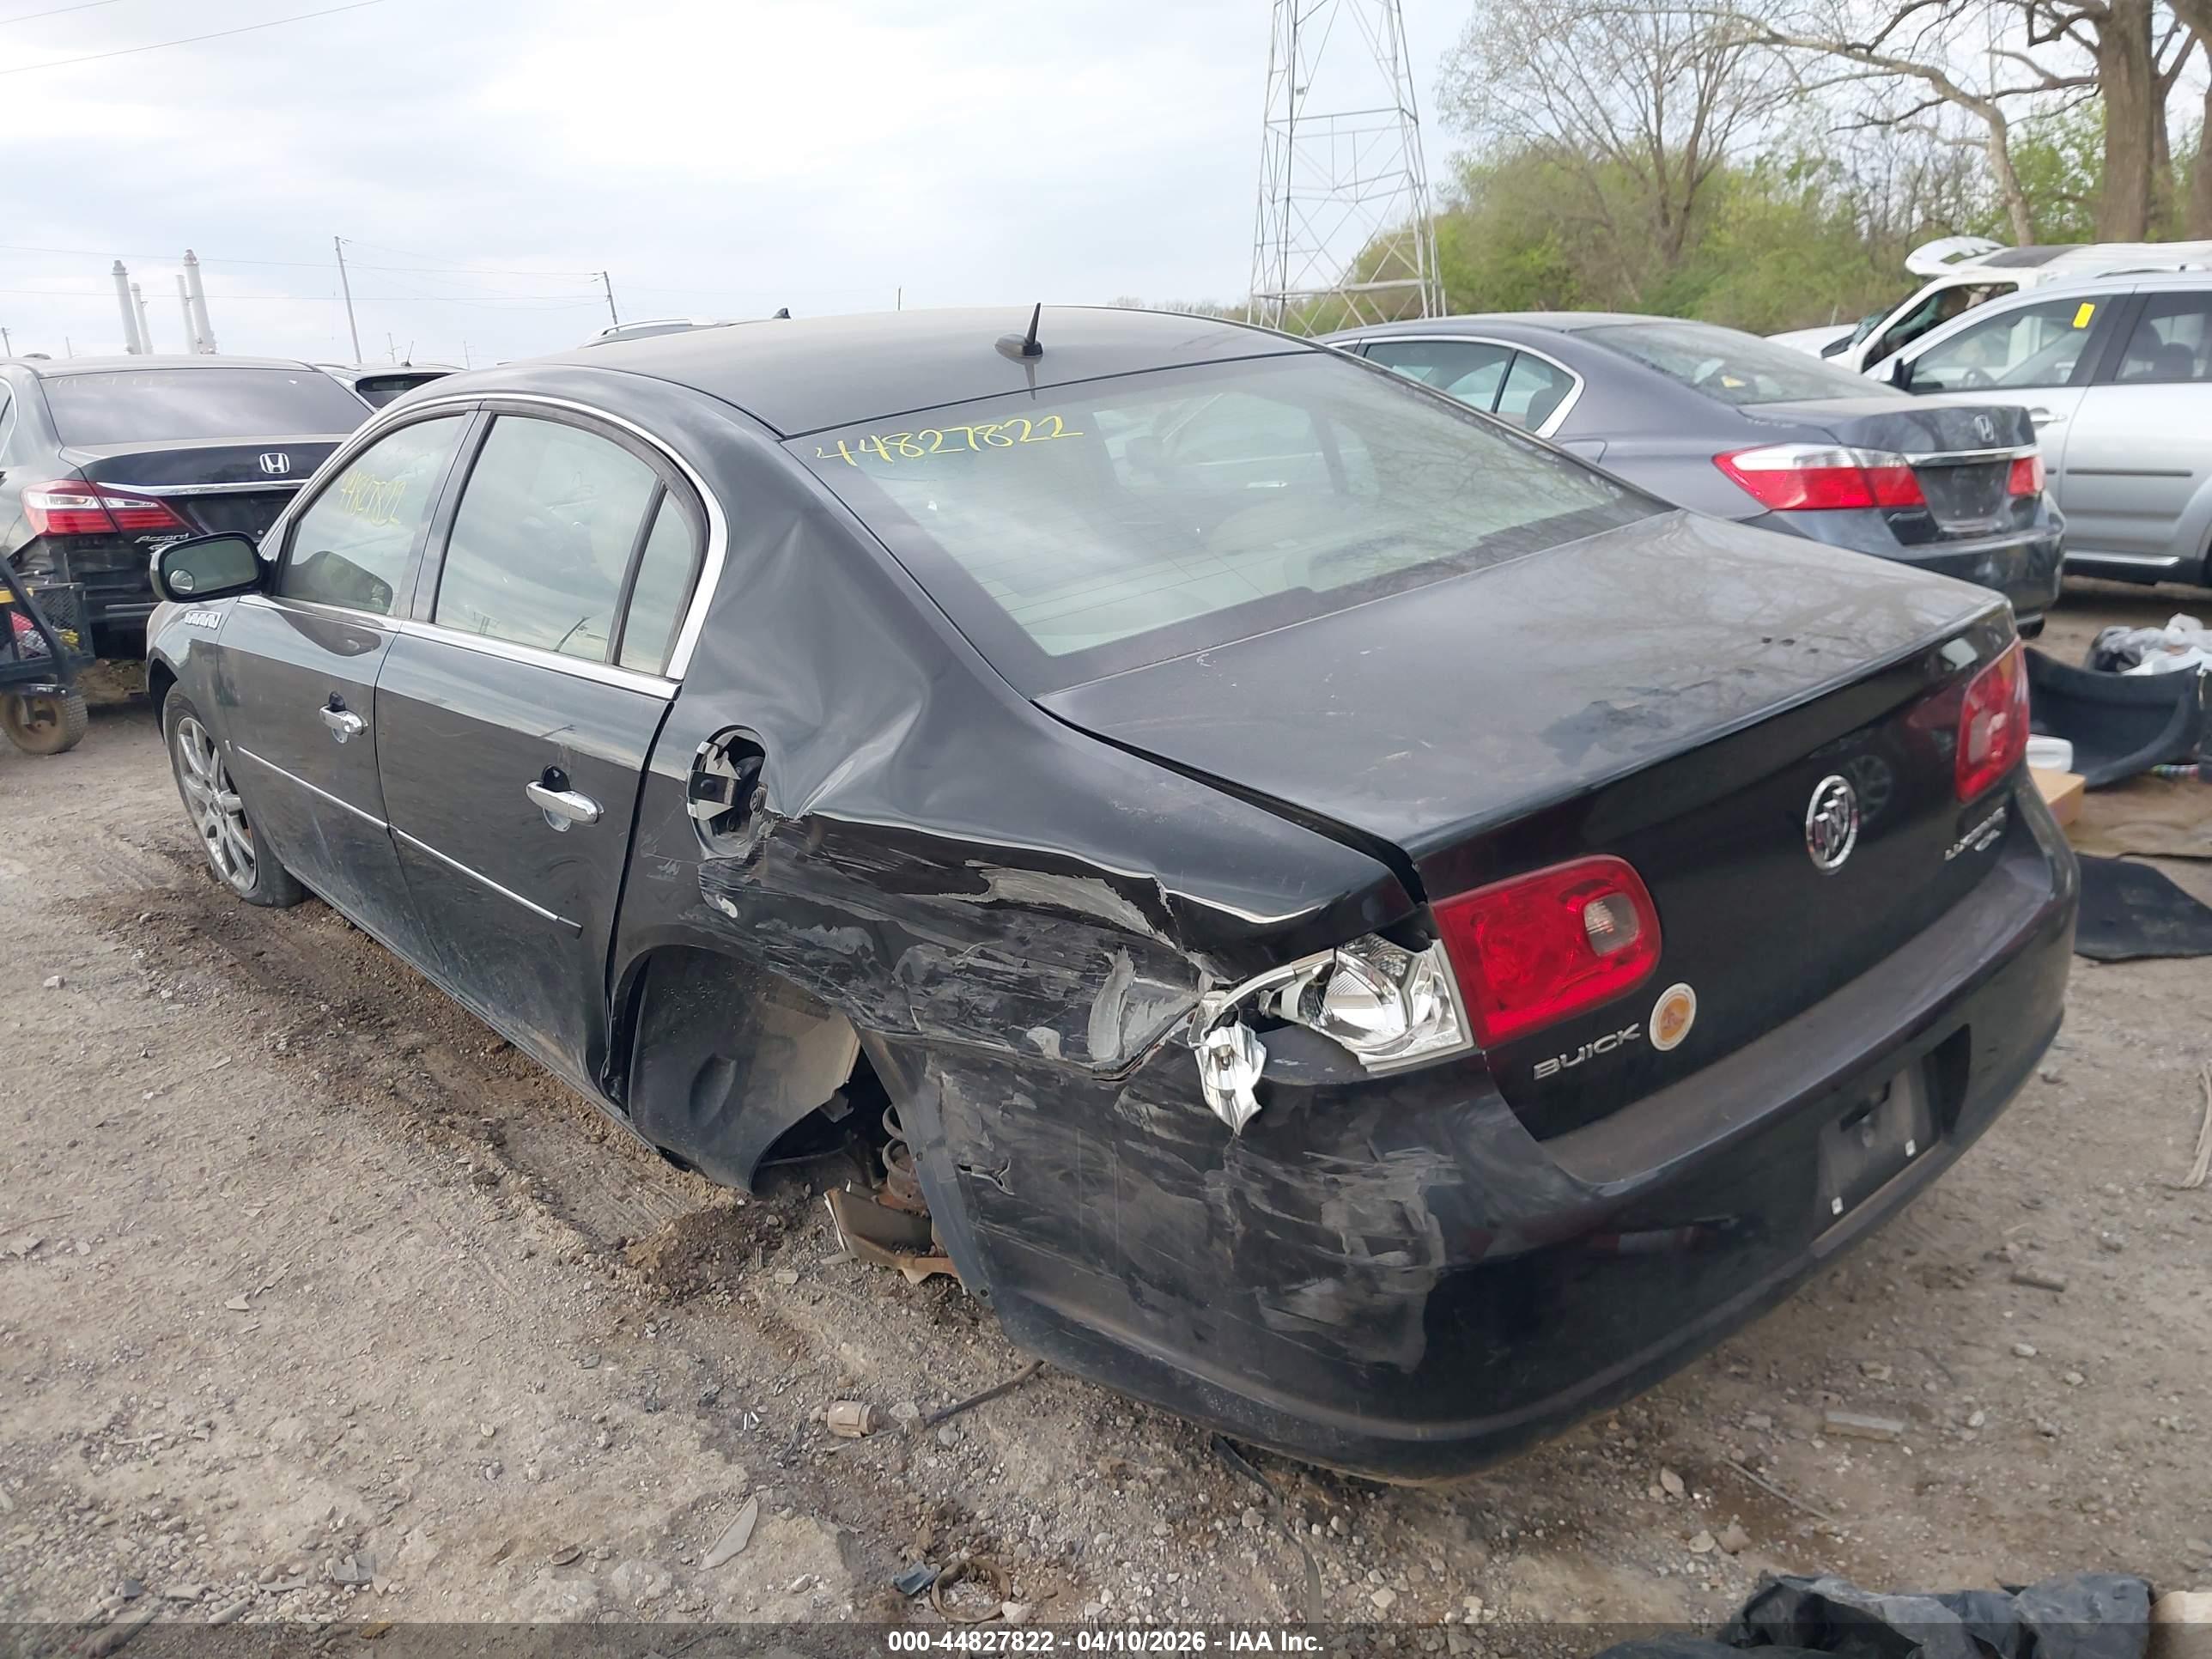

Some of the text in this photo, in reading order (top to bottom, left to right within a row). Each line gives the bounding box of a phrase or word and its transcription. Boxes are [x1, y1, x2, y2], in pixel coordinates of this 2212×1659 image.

[817, 415, 1084, 466] 44827822
[134, 532, 189, 544] Accord
[1533, 1023, 1642, 1080] BUICK
